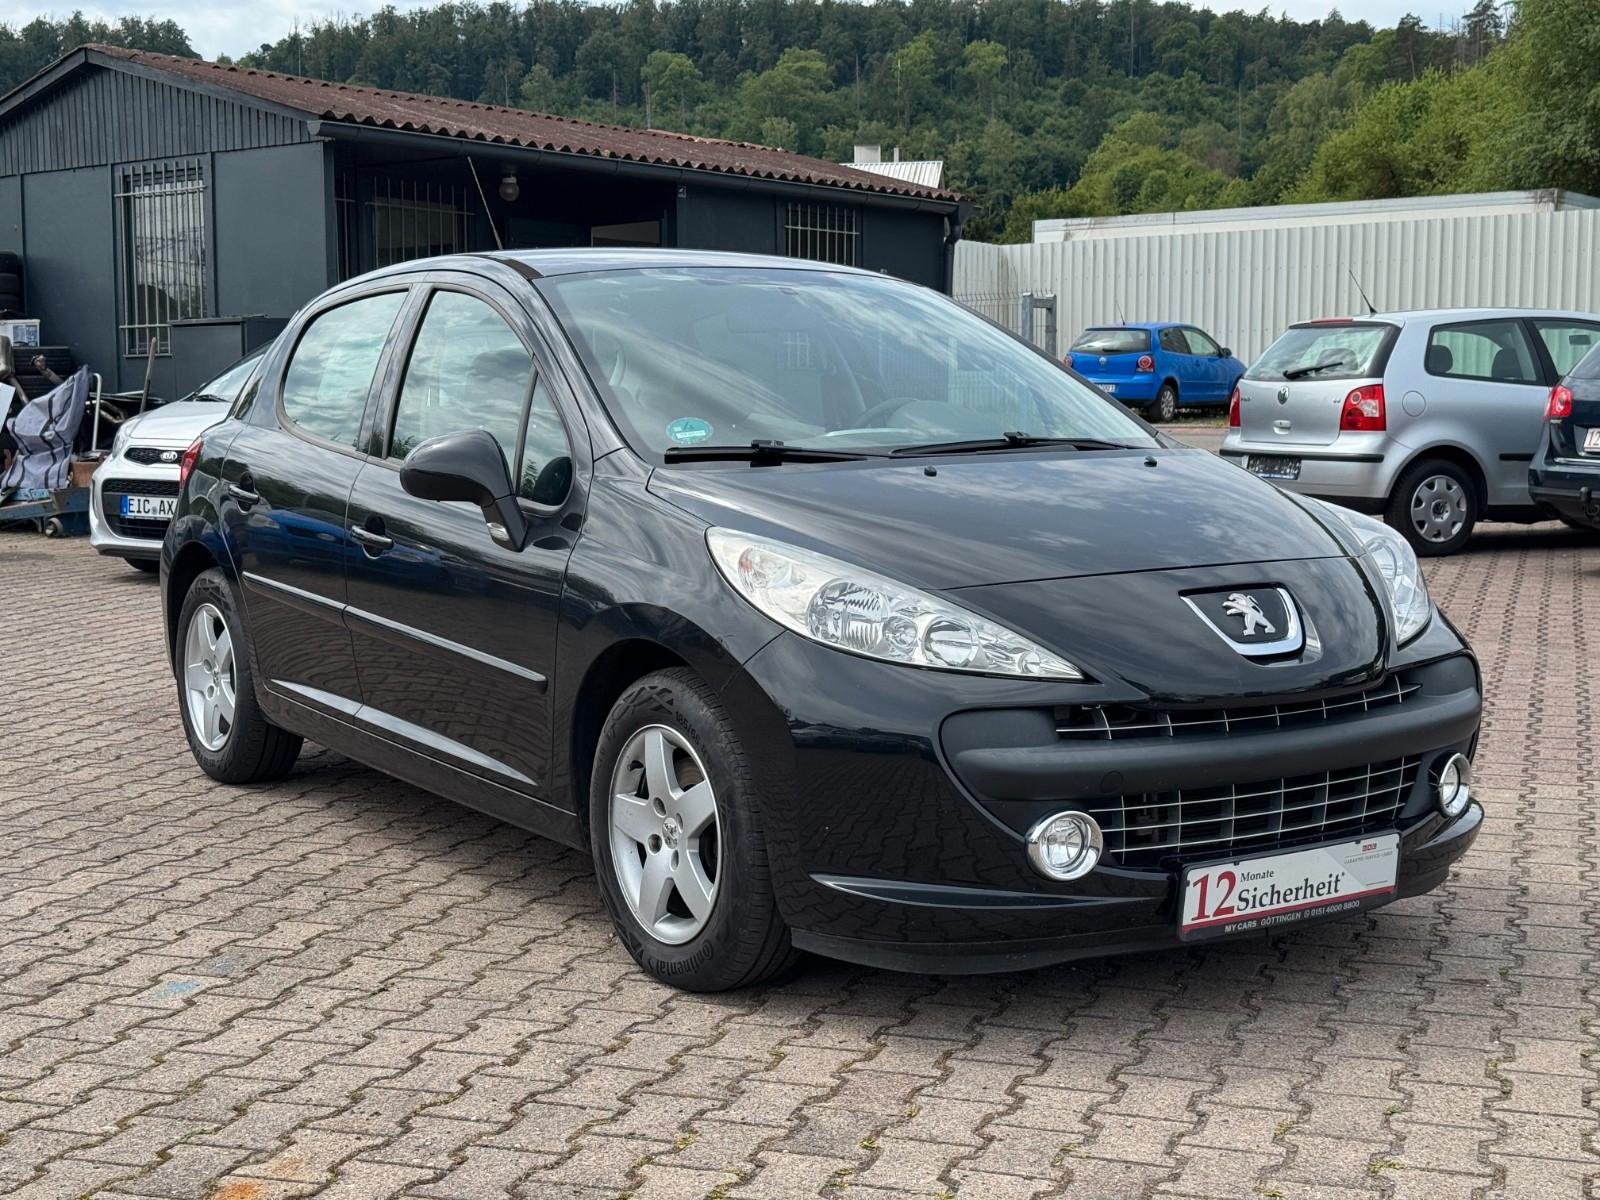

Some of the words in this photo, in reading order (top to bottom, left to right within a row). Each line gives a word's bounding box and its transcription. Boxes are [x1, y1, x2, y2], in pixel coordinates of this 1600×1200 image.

[128, 498, 151, 514] EIC
[159, 500, 174, 515] AX
[1240, 869, 1275, 882] Monate
[1191, 870, 1237, 921] 12
[1224, 923, 1237, 933] MY
[1237, 920, 1257, 930] CARS
[1260, 911, 1301, 925] GÖTTINGEN
[1310, 907, 1325, 917] 0151
[656, 940, 713, 976] Continental
